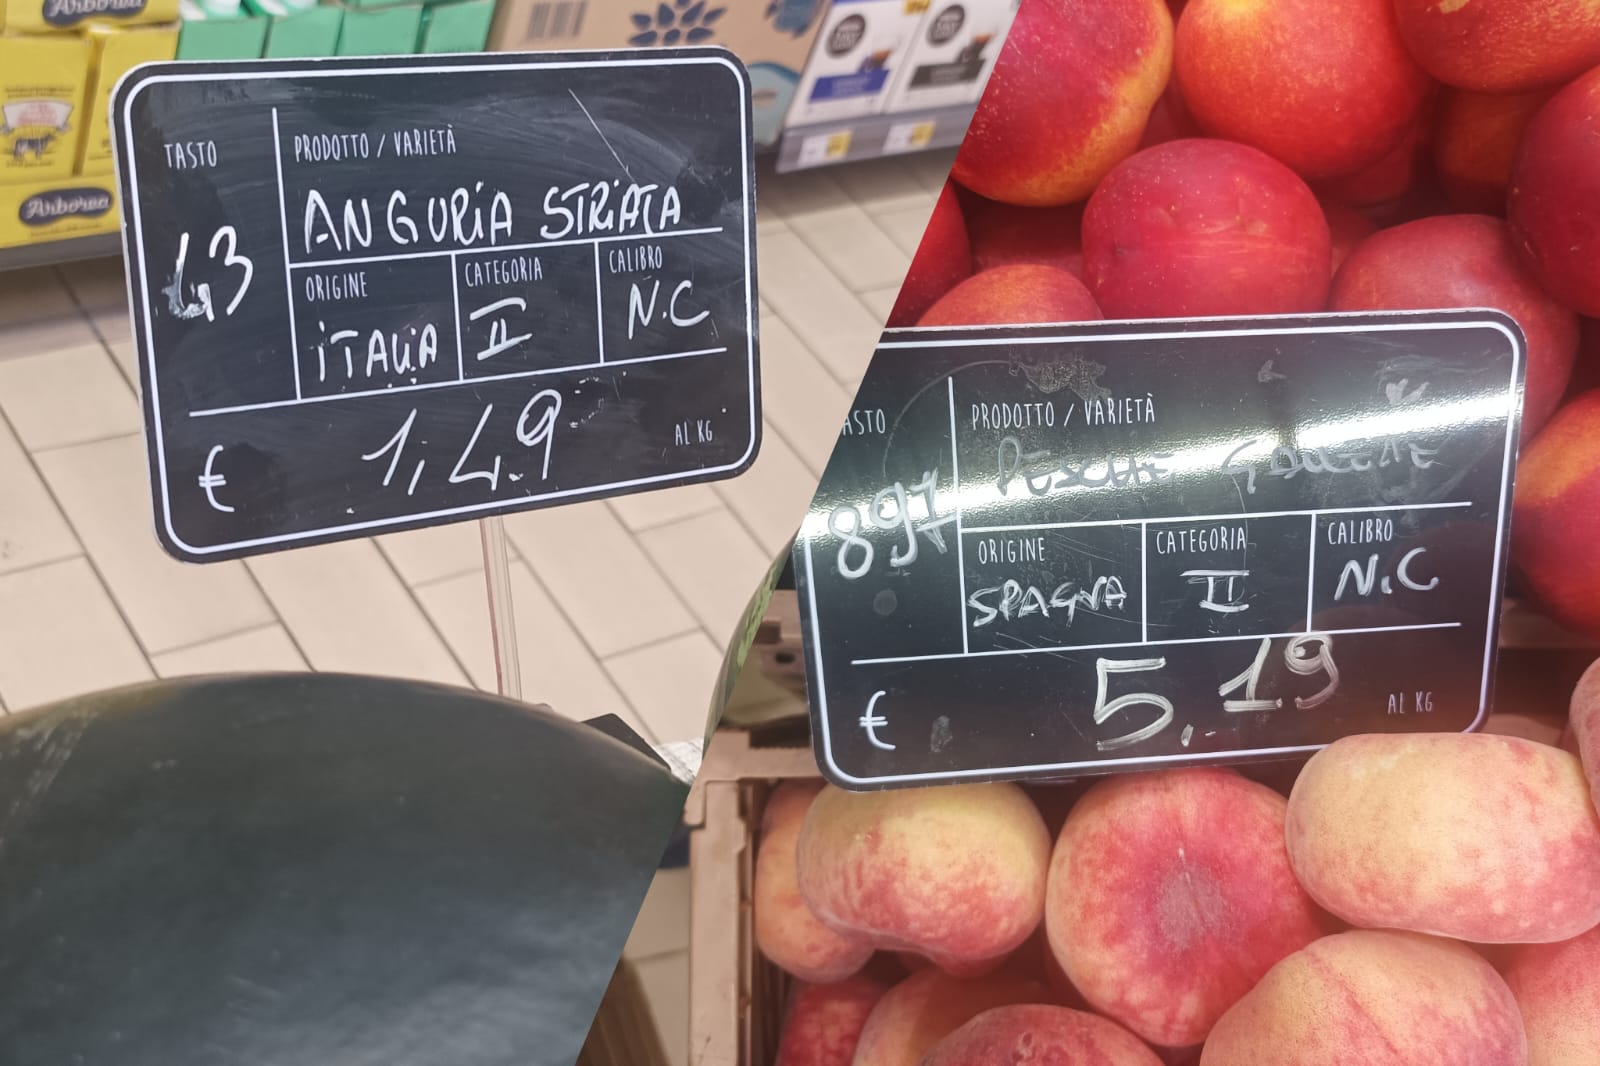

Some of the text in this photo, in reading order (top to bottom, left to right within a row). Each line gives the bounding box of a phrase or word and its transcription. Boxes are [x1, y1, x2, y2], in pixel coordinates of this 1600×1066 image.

[164, 140, 218, 170] TASTO
[294, 124, 457, 163] PRODOTTO / VARIETÀ
[465, 256, 543, 288] CATEGORIA
[609, 246, 663, 274] CALIBRO
[306, 271, 368, 302] ORIGINE
[469, 296, 532, 361] II
[628, 279, 710, 339] N.C
[972, 392, 1156, 431] PRODOTTO / VARIETÀ
[198, 445, 235, 512] €
[675, 422, 690, 446] AL
[697, 419, 713, 443] KG
[978, 536, 1046, 565] ORIGINE
[1156, 525, 1246, 555] CATEGORIA
[1328, 518, 1393, 546] CALIBRO
[967, 575, 1128, 628] SPAGNA
[1179, 569, 1250, 613] II
[859, 690, 896, 750] €
[1387, 692, 1405, 715] AL
[1415, 691, 1434, 713] KG
